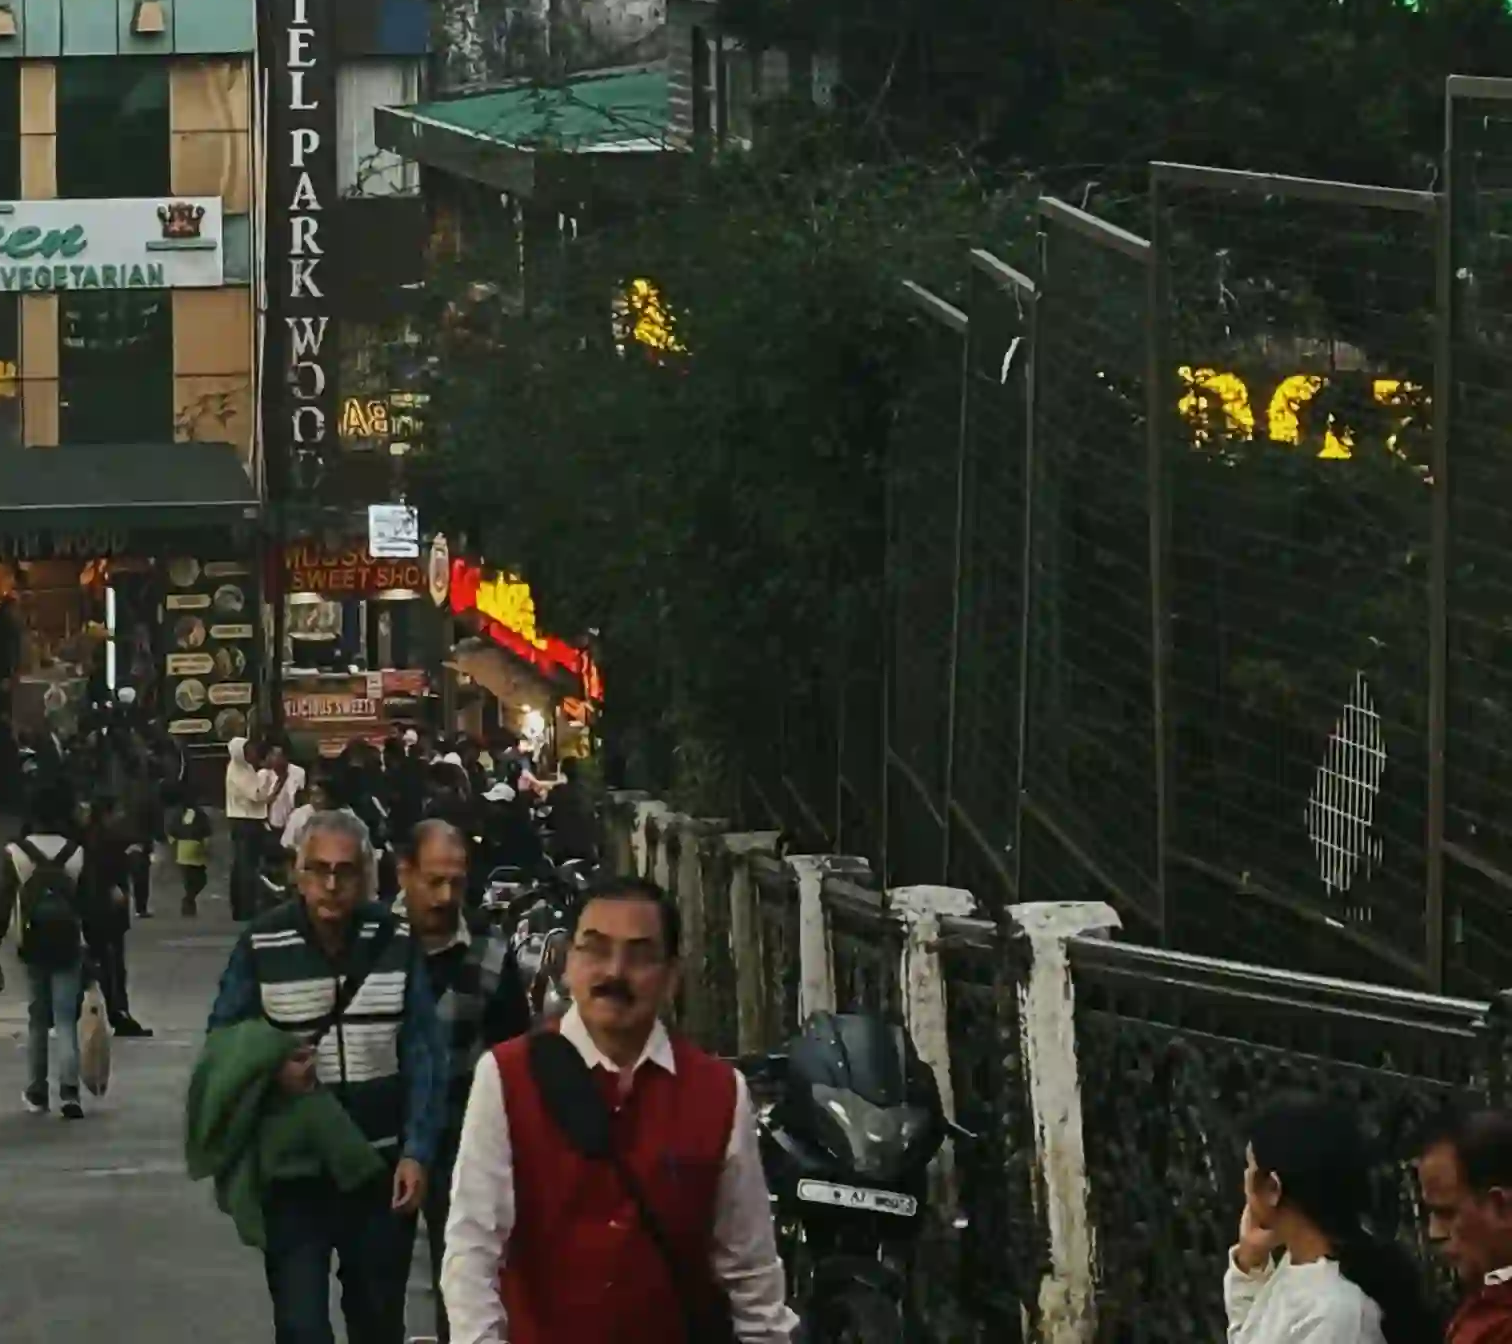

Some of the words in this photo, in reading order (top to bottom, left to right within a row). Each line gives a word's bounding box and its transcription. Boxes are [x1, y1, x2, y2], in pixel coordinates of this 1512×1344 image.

[288, 128, 325, 299] PARK
[0, 262, 164, 290] VEGETARIAN
[292, 568, 371, 590] SWEET
